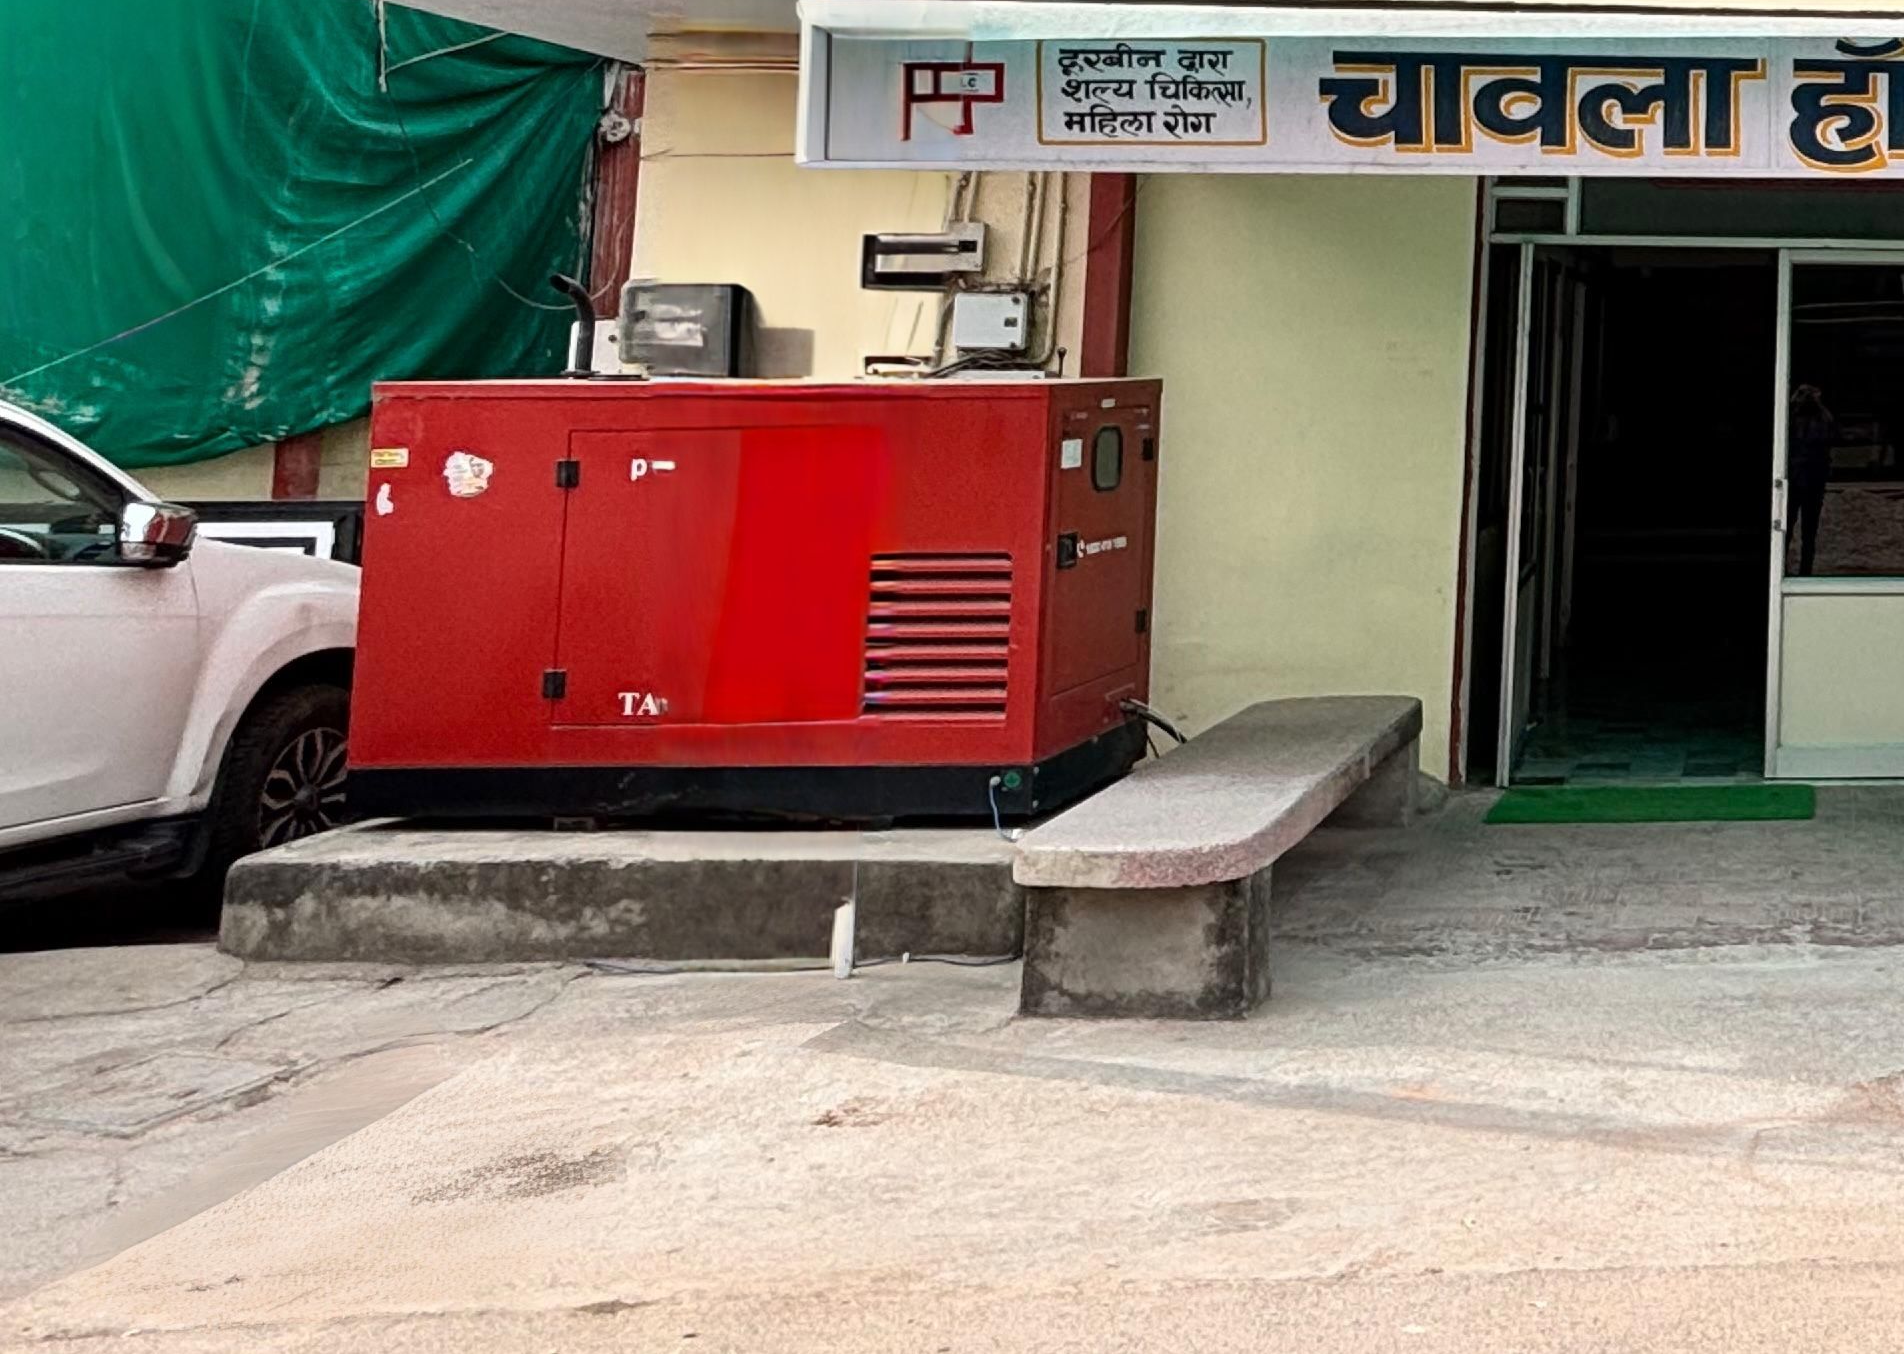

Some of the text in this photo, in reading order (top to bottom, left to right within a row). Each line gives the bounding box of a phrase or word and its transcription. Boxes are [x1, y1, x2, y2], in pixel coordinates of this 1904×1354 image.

[1058, 43, 1167, 76] दूरबीन
[1061, 78, 1138, 103] शल्य
[1319, 49, 1767, 159] चावला
[1063, 104, 1218, 139] महिला रोग
